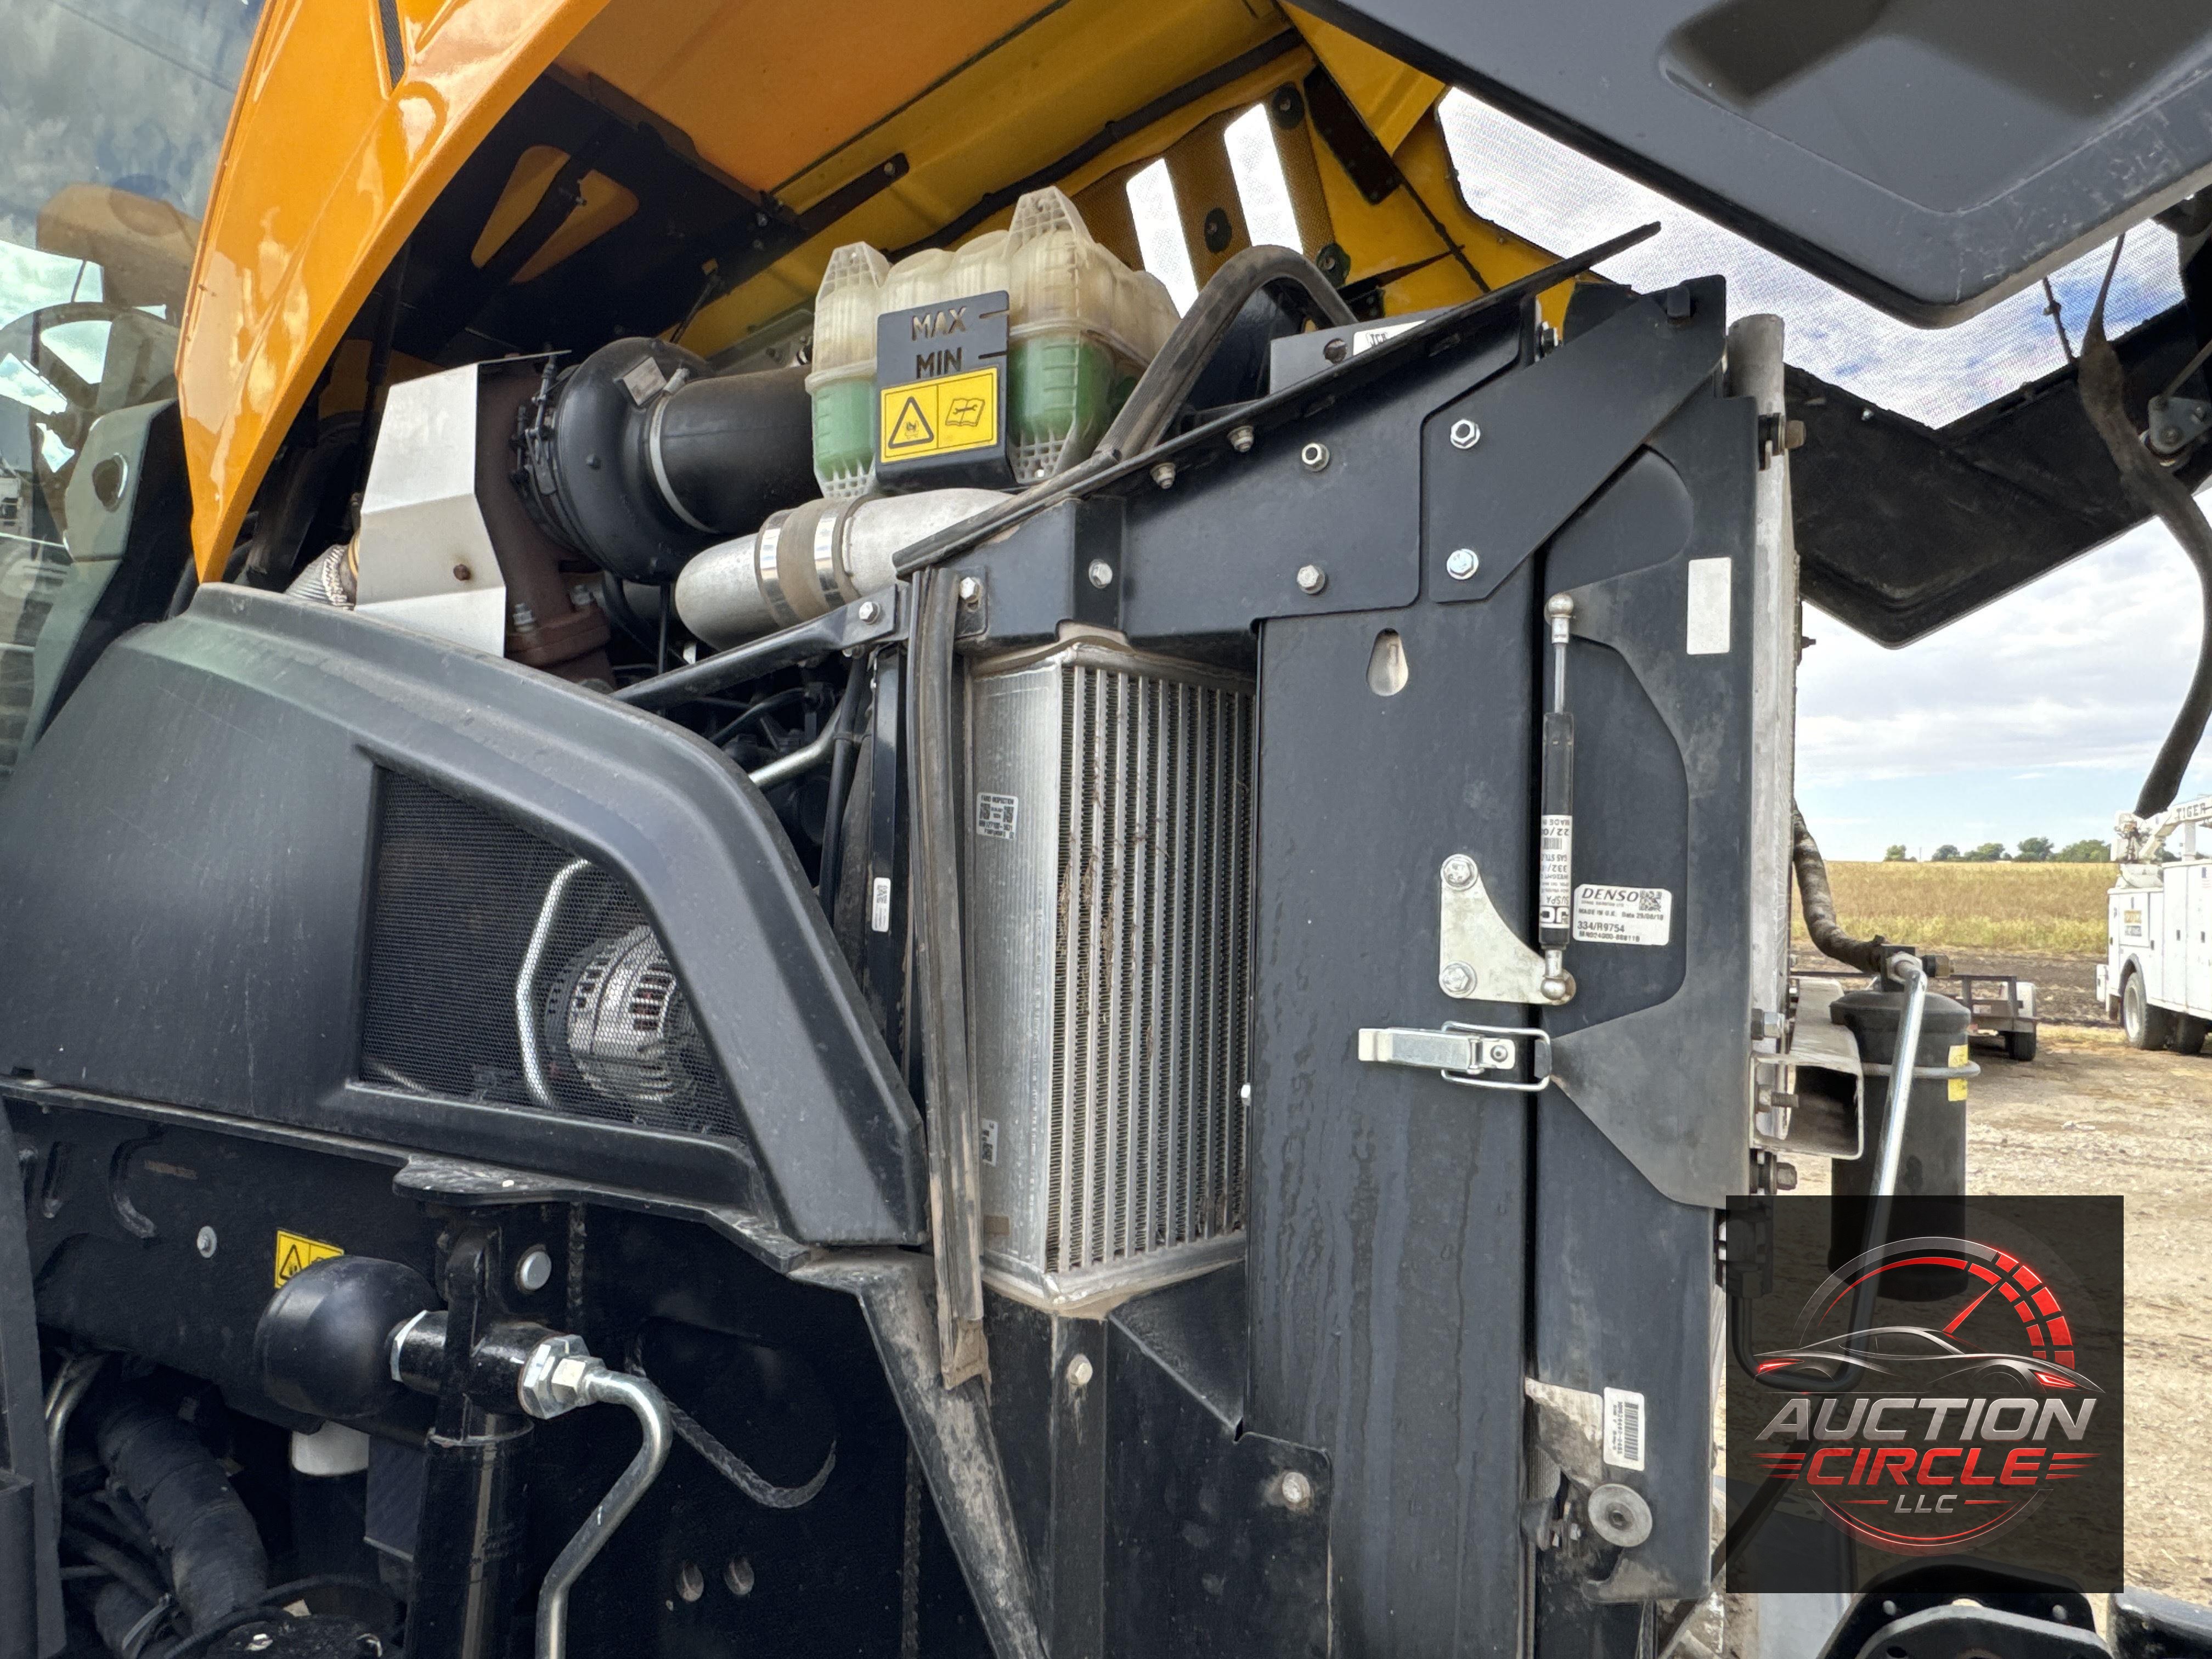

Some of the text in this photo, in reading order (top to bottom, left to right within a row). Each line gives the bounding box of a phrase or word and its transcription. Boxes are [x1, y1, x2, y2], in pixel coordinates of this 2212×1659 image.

[912, 306, 967, 341] MAX
[916, 347, 962, 379] MIN
[2176, 803, 2205, 821] TIGER
[1582, 888, 1639, 902] DENSO
